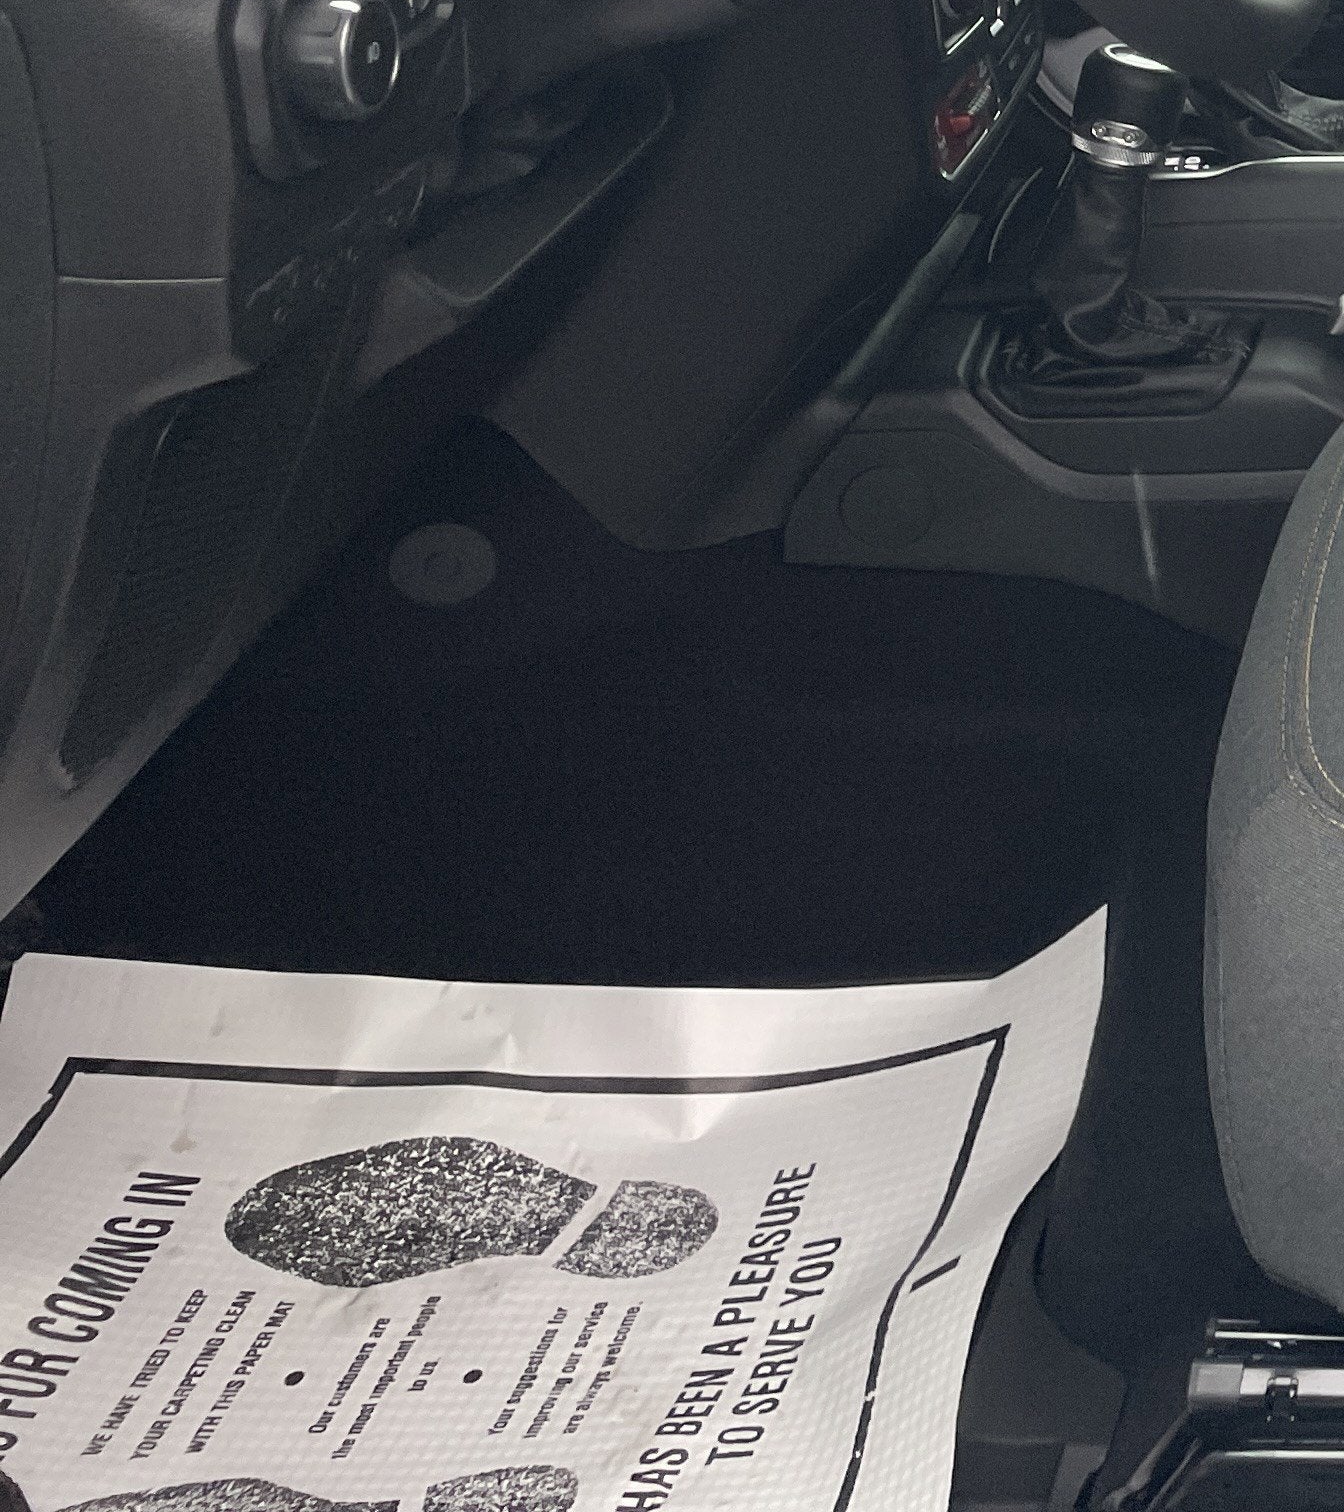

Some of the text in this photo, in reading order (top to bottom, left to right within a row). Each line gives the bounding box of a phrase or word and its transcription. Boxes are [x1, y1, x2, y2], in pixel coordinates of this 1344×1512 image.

[27, 1216, 174, 1343] COMING
[123, 1171, 201, 1207] IN
[81, 1289, 208, 1456] WE HAVE TRIED TO KEEP
[129, 1290, 257, 1460] YOUR CARPETING CLEAN
[184, 1300, 296, 1454] WITH THIS PAPER MAT
[308, 1317, 391, 1434] Our customers are
[331, 1295, 442, 1460] the most important people
[408, 1380, 428, 1392] to
[488, 1306, 569, 1436] Your suggestions for
[522, 1301, 609, 1439] improving our service
[562, 1300, 644, 1435] are always welcome.
[615, 1162, 817, 1512] HAS BEEN A PLEASURE
[704, 1236, 843, 1466] TO SERVE YOU
